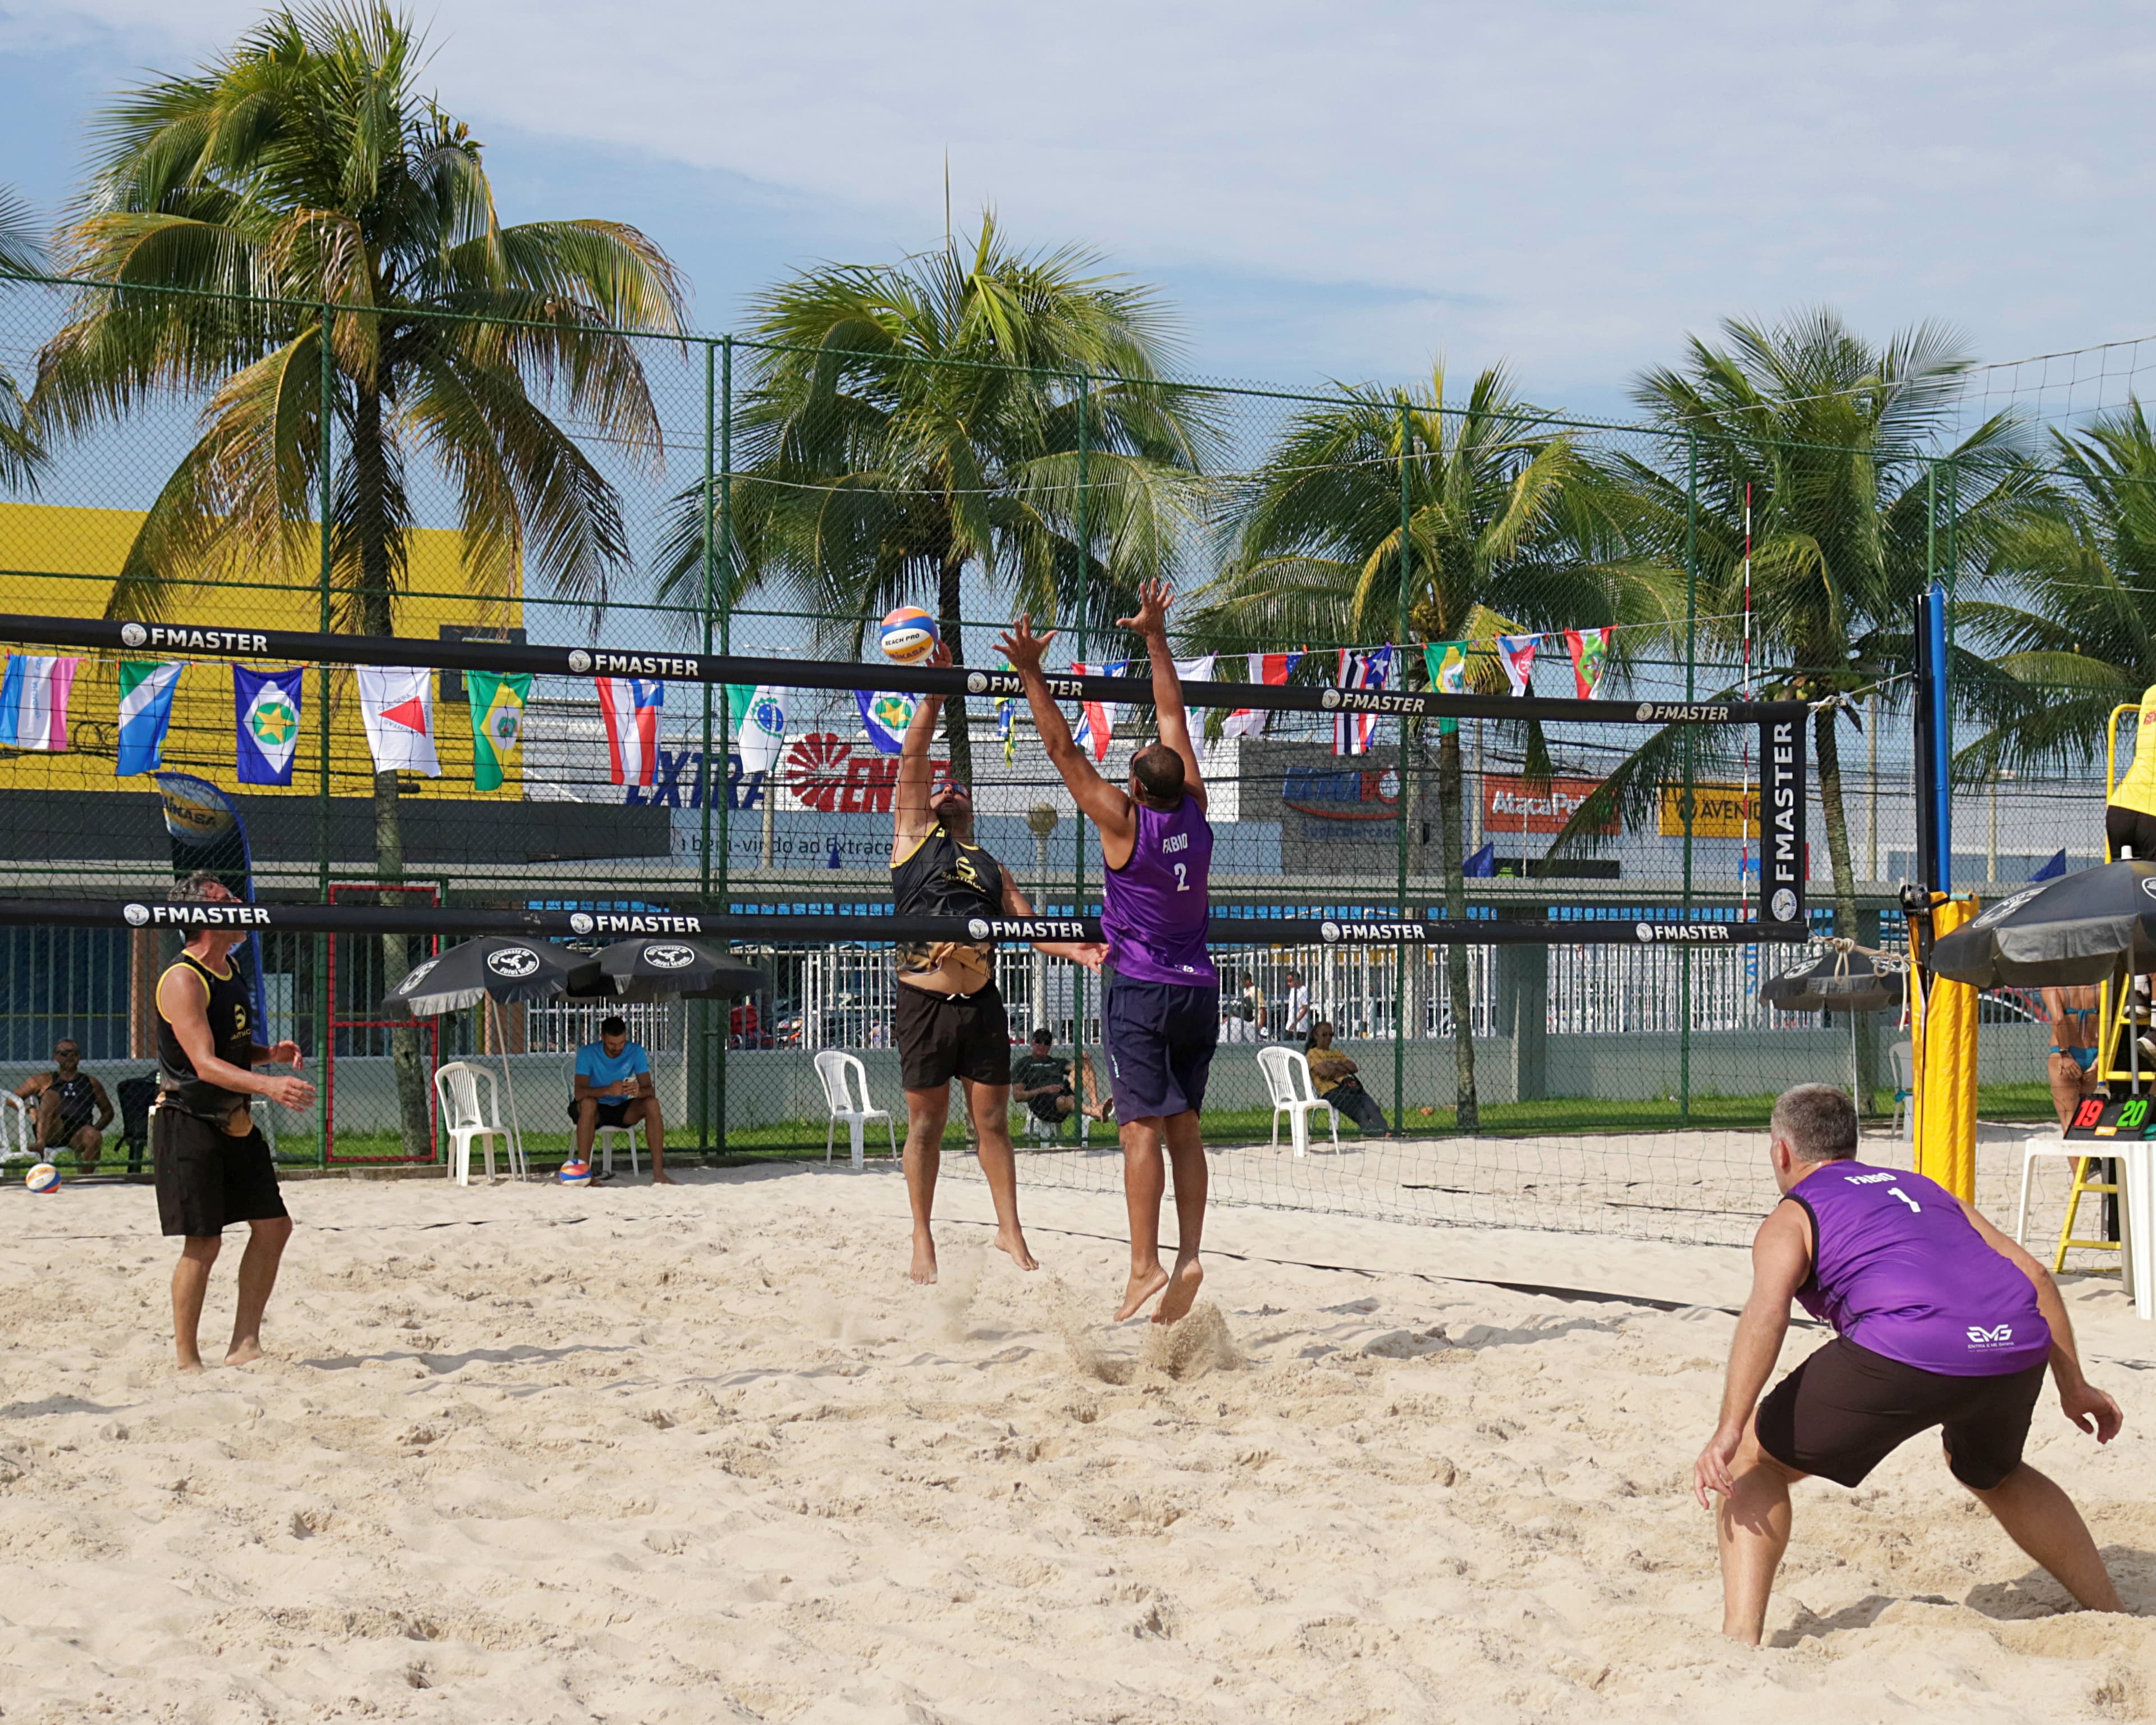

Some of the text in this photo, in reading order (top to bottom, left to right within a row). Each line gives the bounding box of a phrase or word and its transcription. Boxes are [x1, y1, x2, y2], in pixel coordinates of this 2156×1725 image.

[151, 628, 268, 652] FMASTER
[885, 633, 920, 646] BEACH PRO
[595, 654, 698, 676] FMASTER
[990, 676, 1083, 696] FMTER
[1341, 693, 1425, 713] FMASTER
[1654, 706, 1729, 720] FMASTER
[1774, 722, 1794, 881] FMASTER
[799, 841, 820, 853] ao
[1162, 833, 1188, 854] FABIO
[1174, 862, 1190, 892] 2
[153, 907, 271, 924] FMASTER
[596, 916, 701, 932] FMASTER
[992, 922, 1085, 938] FMASTER
[1341, 925, 1426, 939] FMASTER
[1655, 926, 1729, 939] FMASTER
[2073, 1099, 2148, 1127] 19 20
[1843, 1172, 1897, 1185] FABIO
[1887, 1187, 1921, 1213] 1
